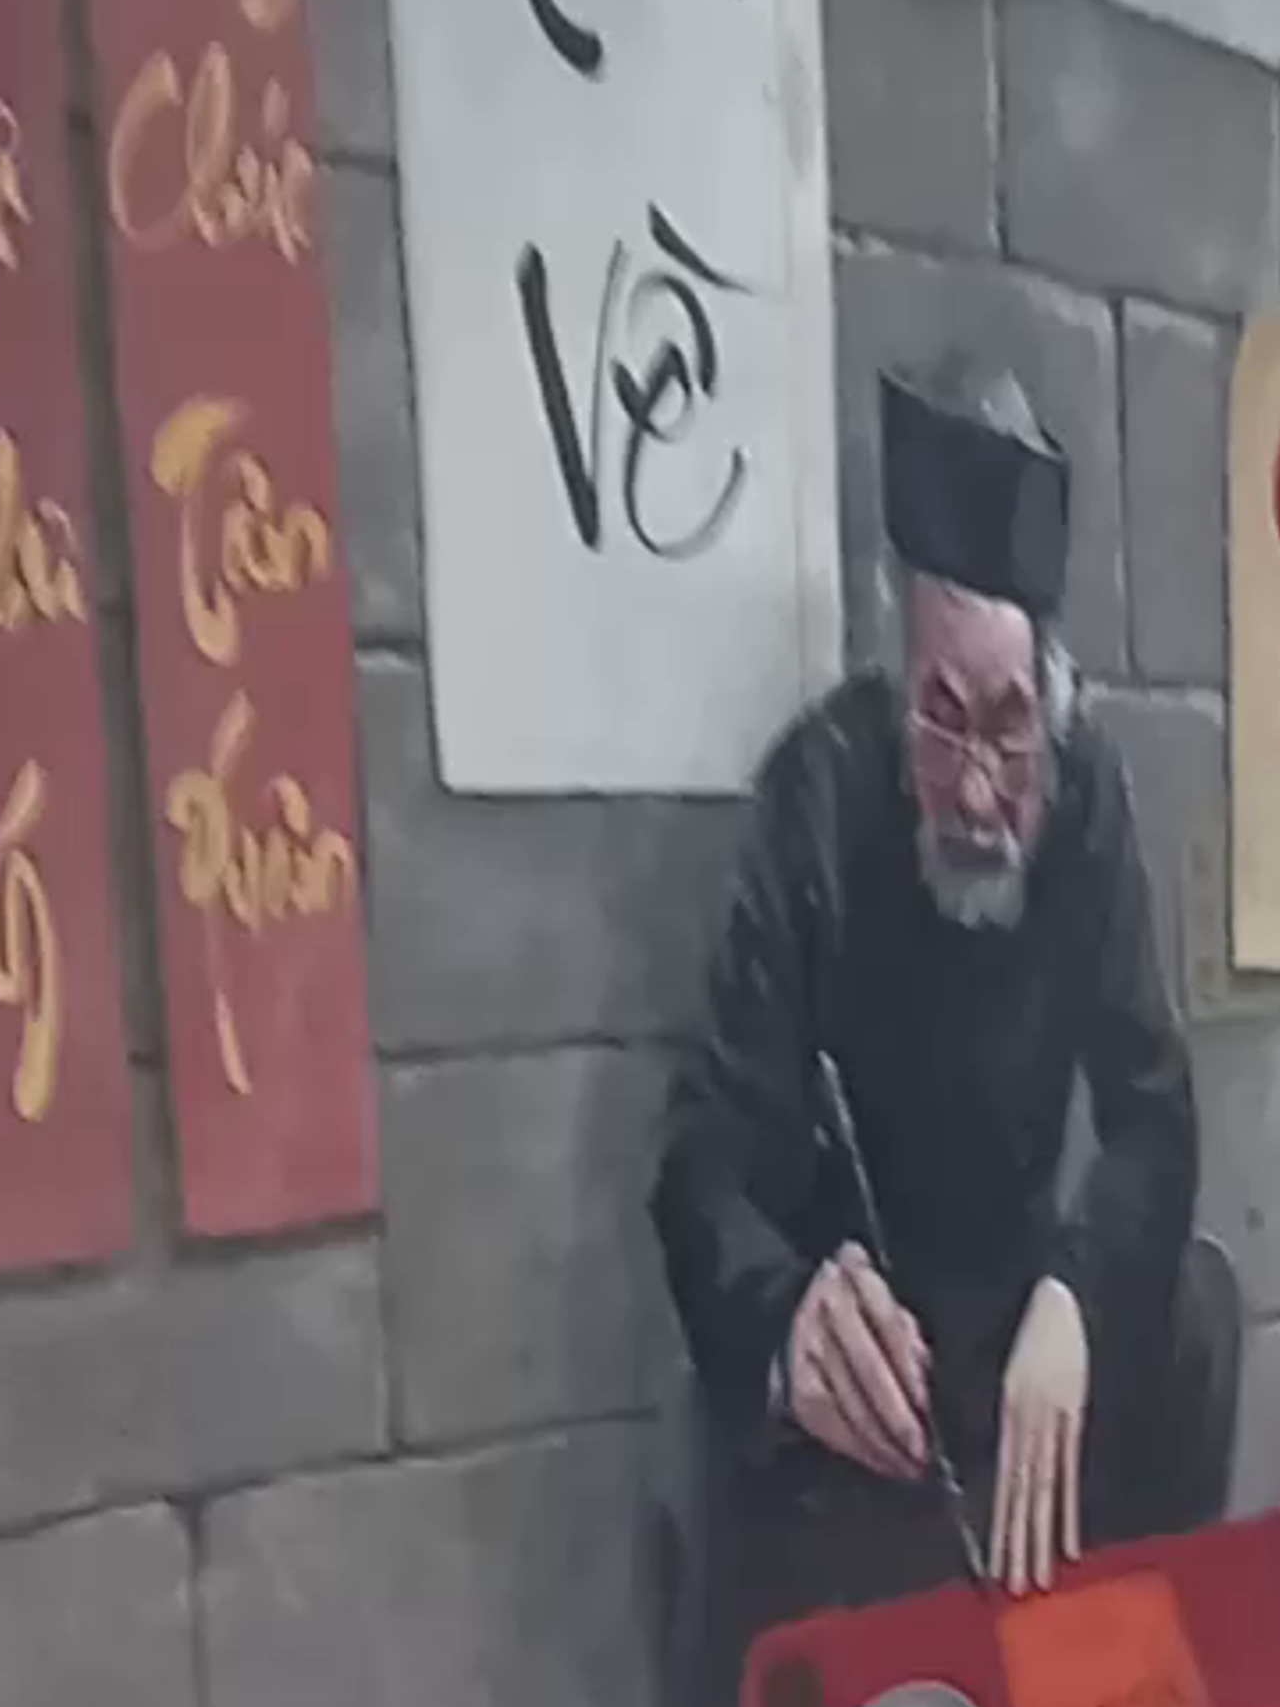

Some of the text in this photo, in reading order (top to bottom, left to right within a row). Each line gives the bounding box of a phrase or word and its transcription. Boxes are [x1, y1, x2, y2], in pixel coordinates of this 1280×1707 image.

[109, 41, 314, 265] Chúc
[150, 395, 330, 666] Tân
[520, 202, 756, 560] Về
[167, 690, 356, 1095] Xuân
